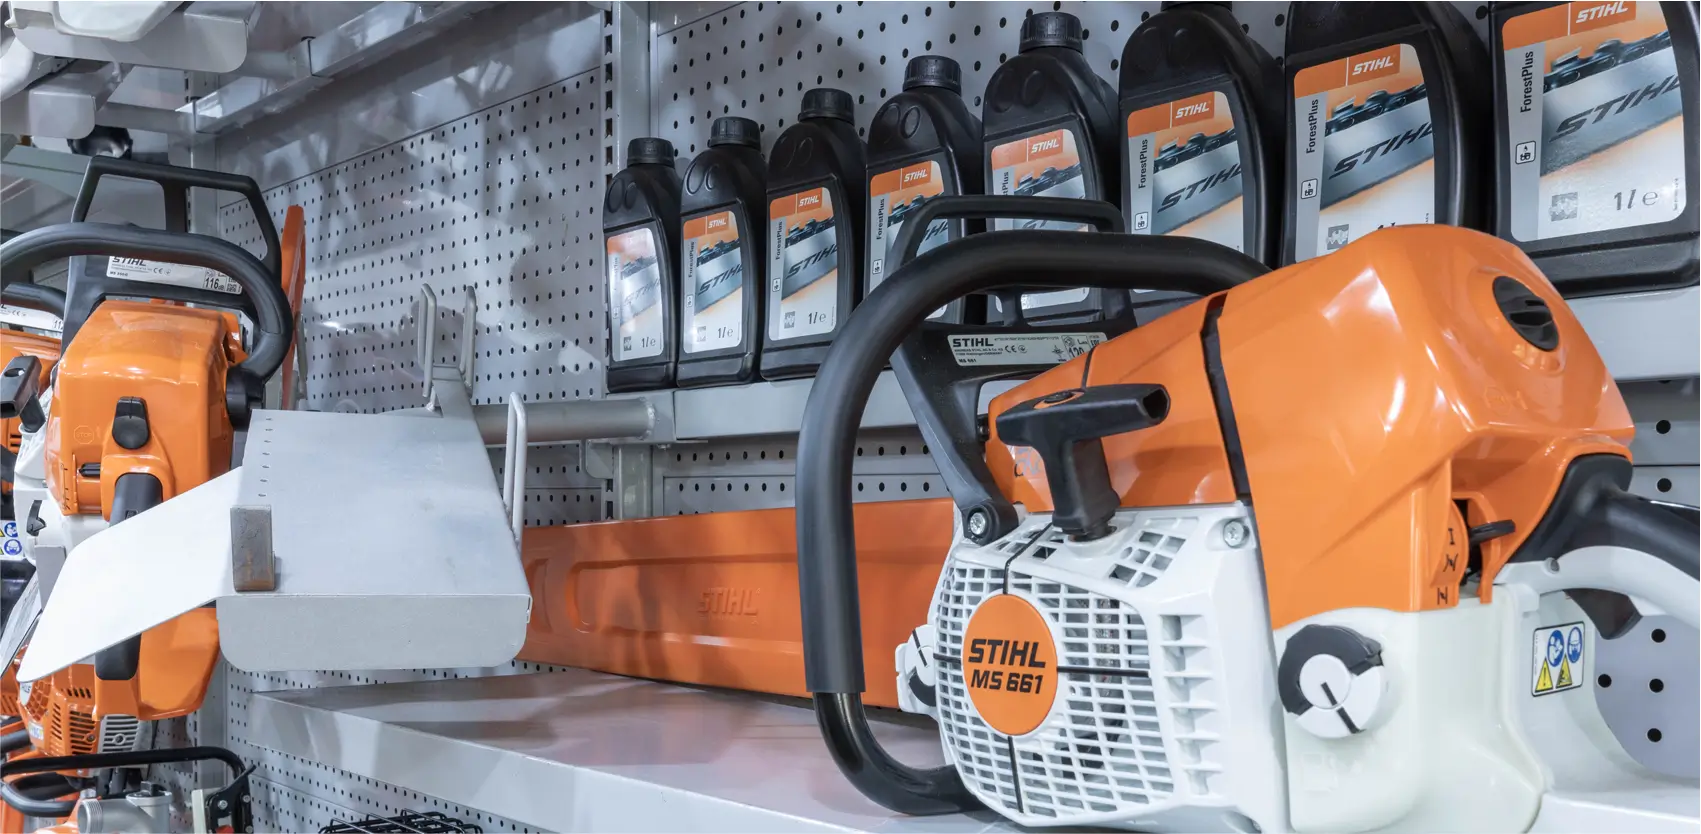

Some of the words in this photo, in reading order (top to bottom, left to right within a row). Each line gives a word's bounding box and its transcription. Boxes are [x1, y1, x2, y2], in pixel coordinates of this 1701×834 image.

[1576, 2, 1628, 23] STIHL
[1352, 57, 1394, 75] STIHL
[1520, 51, 1534, 113] ForestPlus
[1175, 101, 1210, 119] STIHL
[1306, 98, 1319, 154] ForestPlus
[1031, 139, 1059, 154] STIHL
[1138, 139, 1148, 189] ForestPlus
[904, 169, 928, 182] STIHL
[798, 194, 820, 207] STIHL
[708, 217, 727, 229] STIHL
[876, 198, 885, 240] ForestPlus
[775, 221, 783, 260] ForestPlus
[205, 277, 219, 289] 116
[953, 338, 994, 347] STIHL
[697, 588, 758, 616] STIHL
[968, 638, 1046, 668] STIHL
[970, 669, 1003, 690] MS
[1006, 672, 1043, 694] 661
